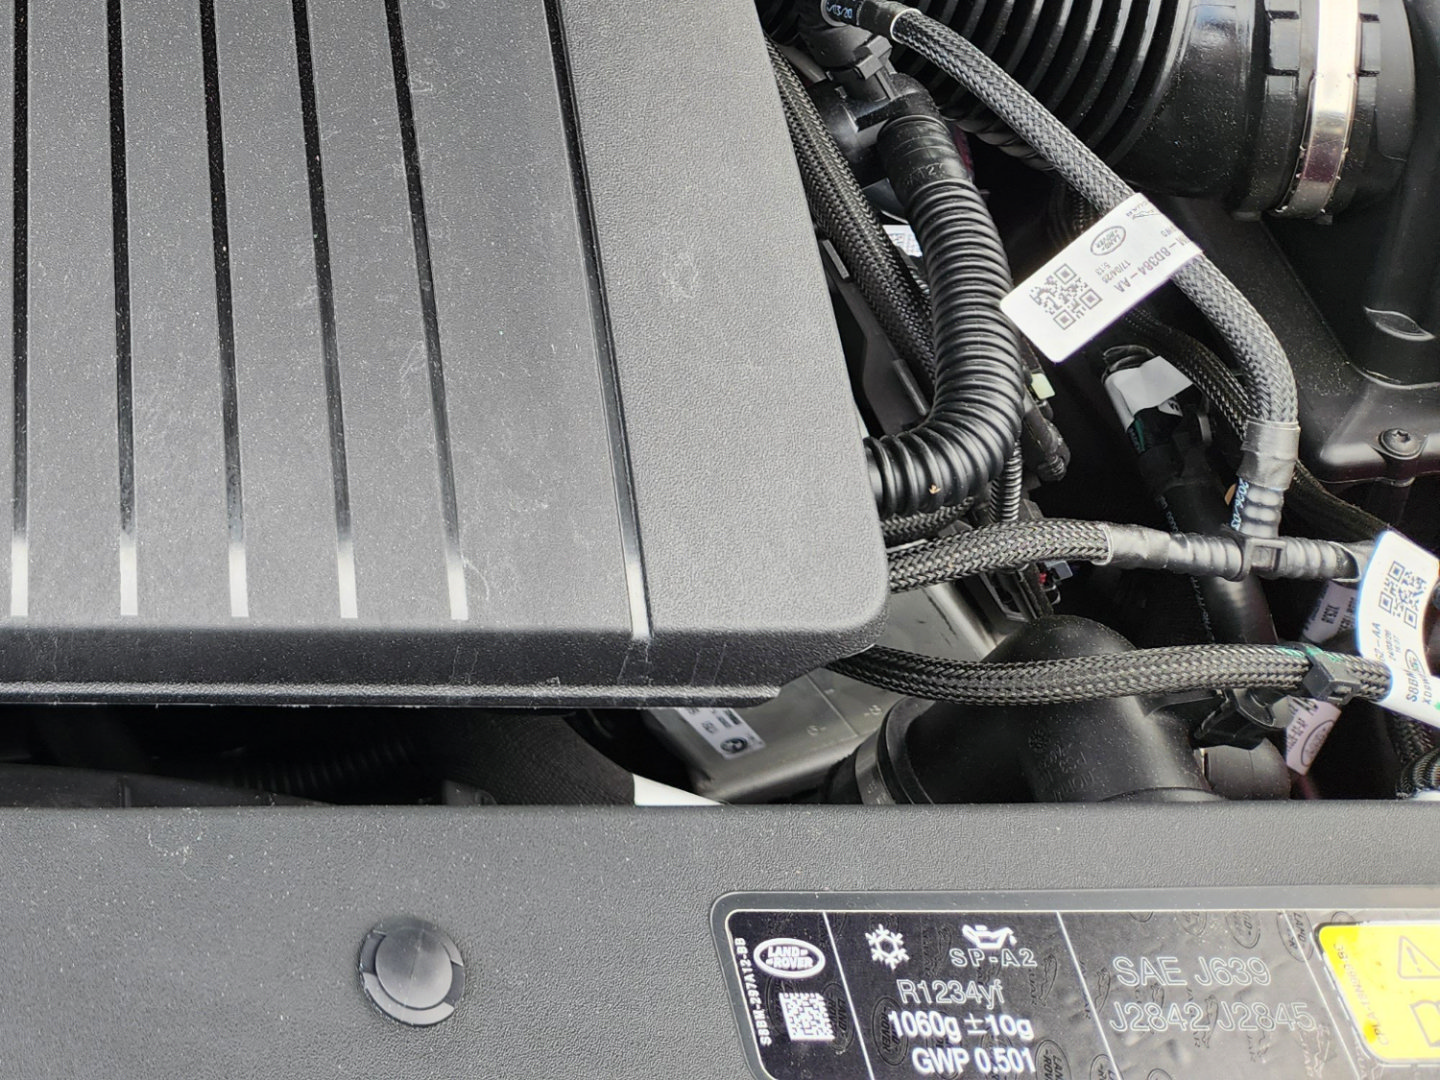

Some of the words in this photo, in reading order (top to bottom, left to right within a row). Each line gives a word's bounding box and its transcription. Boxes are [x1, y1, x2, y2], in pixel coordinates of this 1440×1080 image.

[767, 945, 800, 958] LAND
[773, 956, 813, 970] ROVER
[1112, 956, 1188, 987] SAE
[1194, 957, 1271, 986] J639
[896, 979, 1006, 1010] R1234yf
[888, 1010, 962, 1044] 1060g
[1109, 1001, 1211, 1032] J2842
[1217, 1001, 1317, 1032] J2845
[911, 1047, 970, 1074] GWP
[974, 1047, 1036, 1074] 0.501
